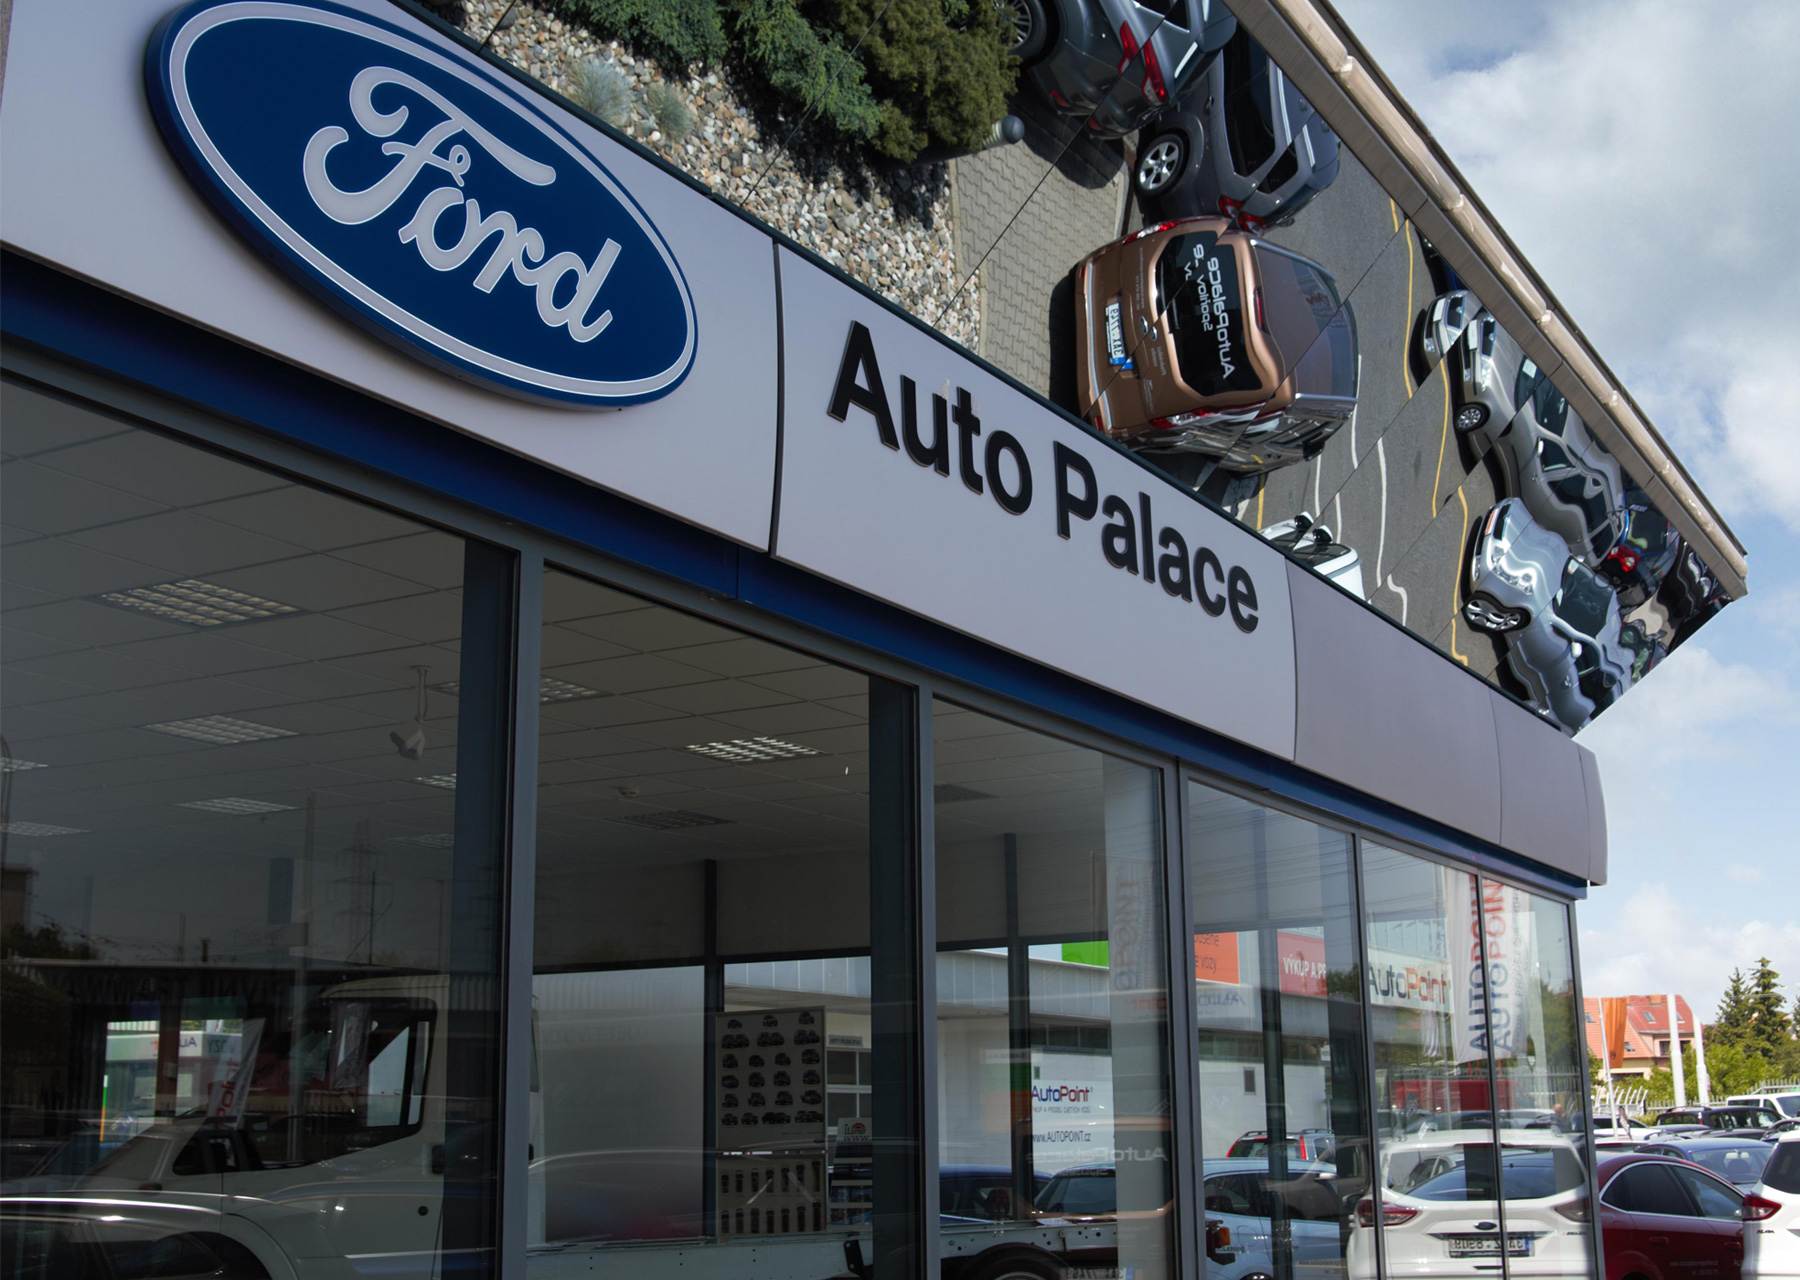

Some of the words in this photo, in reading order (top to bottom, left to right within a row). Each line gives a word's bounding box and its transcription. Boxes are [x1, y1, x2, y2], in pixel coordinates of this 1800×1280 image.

[303, 65, 622, 343] Ford
[827, 320, 1033, 515] Auto
[1053, 440, 1258, 633] Palace
[1200, 956, 1217, 975] vozy
[1283, 953, 1309, 977] VÝKUP
[1311, 965, 1318, 979] A
[1031, 1085, 1091, 1102] AutoPoint
